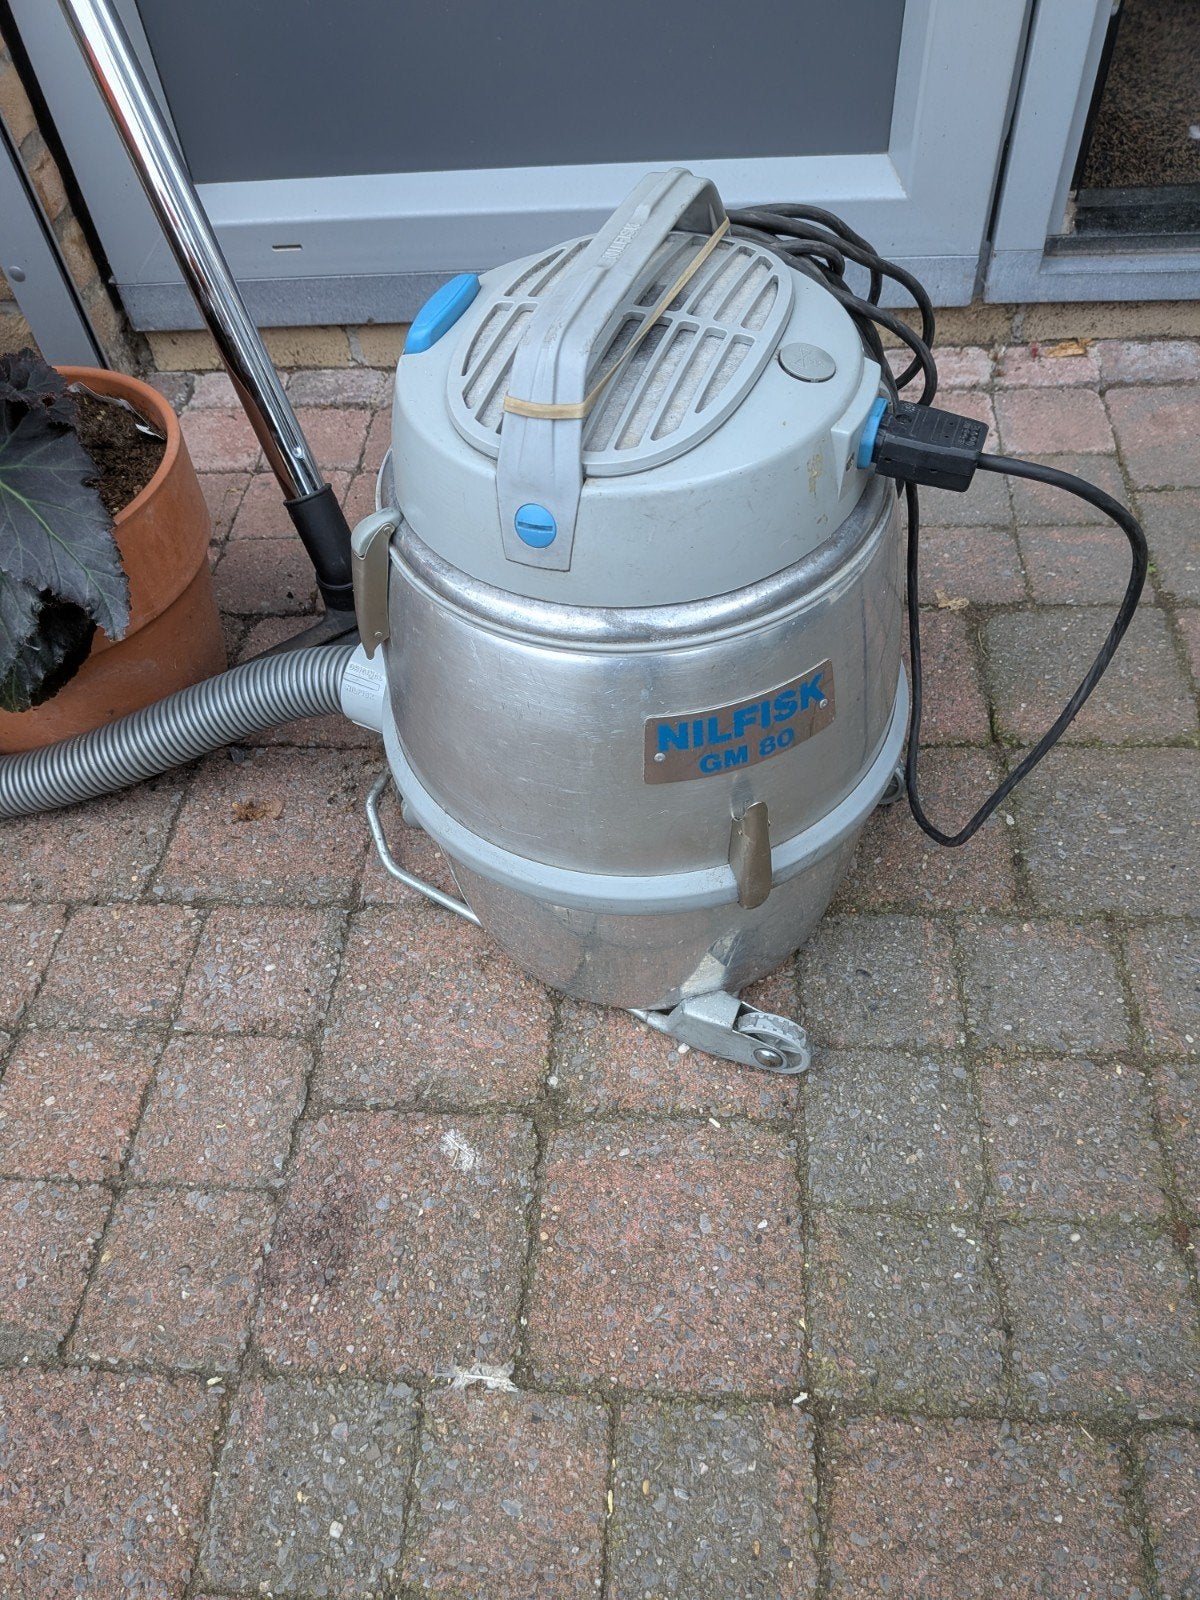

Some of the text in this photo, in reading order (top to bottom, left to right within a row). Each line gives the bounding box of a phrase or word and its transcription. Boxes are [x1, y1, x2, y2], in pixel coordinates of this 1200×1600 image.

[601, 222, 641, 260] NILFISK
[656, 672, 826, 753] NILFISK
[699, 727, 796, 774] GM 80
